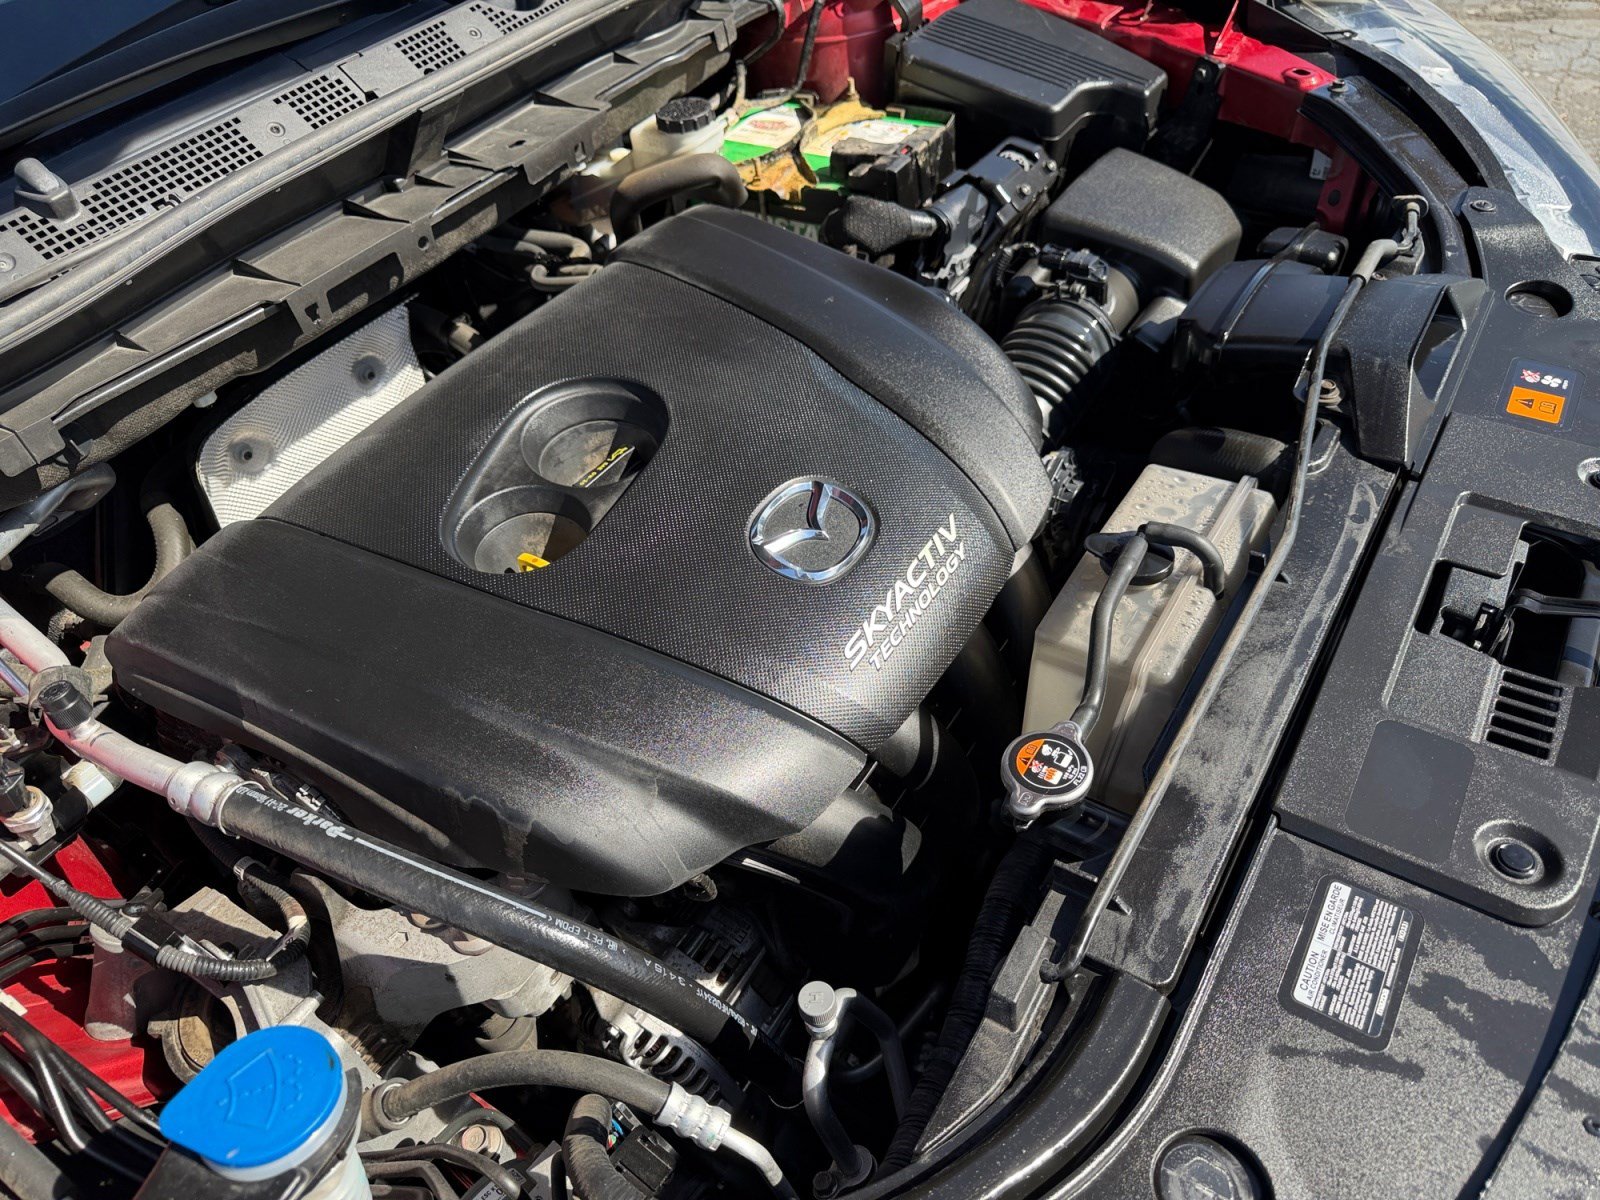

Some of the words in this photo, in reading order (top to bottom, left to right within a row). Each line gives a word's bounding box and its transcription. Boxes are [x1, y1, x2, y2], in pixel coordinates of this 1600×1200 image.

[844, 513, 958, 672] SKYACTIV
[868, 542, 966, 671] TECHNOLOGY
[286, 807, 347, 838] Parker
[1328, 884, 1342, 911] GARDE
[554, 919, 581, 935] EPDM
[1317, 922, 1329, 941] MISE
[1324, 911, 1333, 922] EN
[1329, 898, 1345, 934] CLIMATISEUR
[1300, 951, 1319, 991] CAUTION
[1306, 990, 1314, 1001] AIR
[1310, 949, 1328, 990] CONDITIONER
